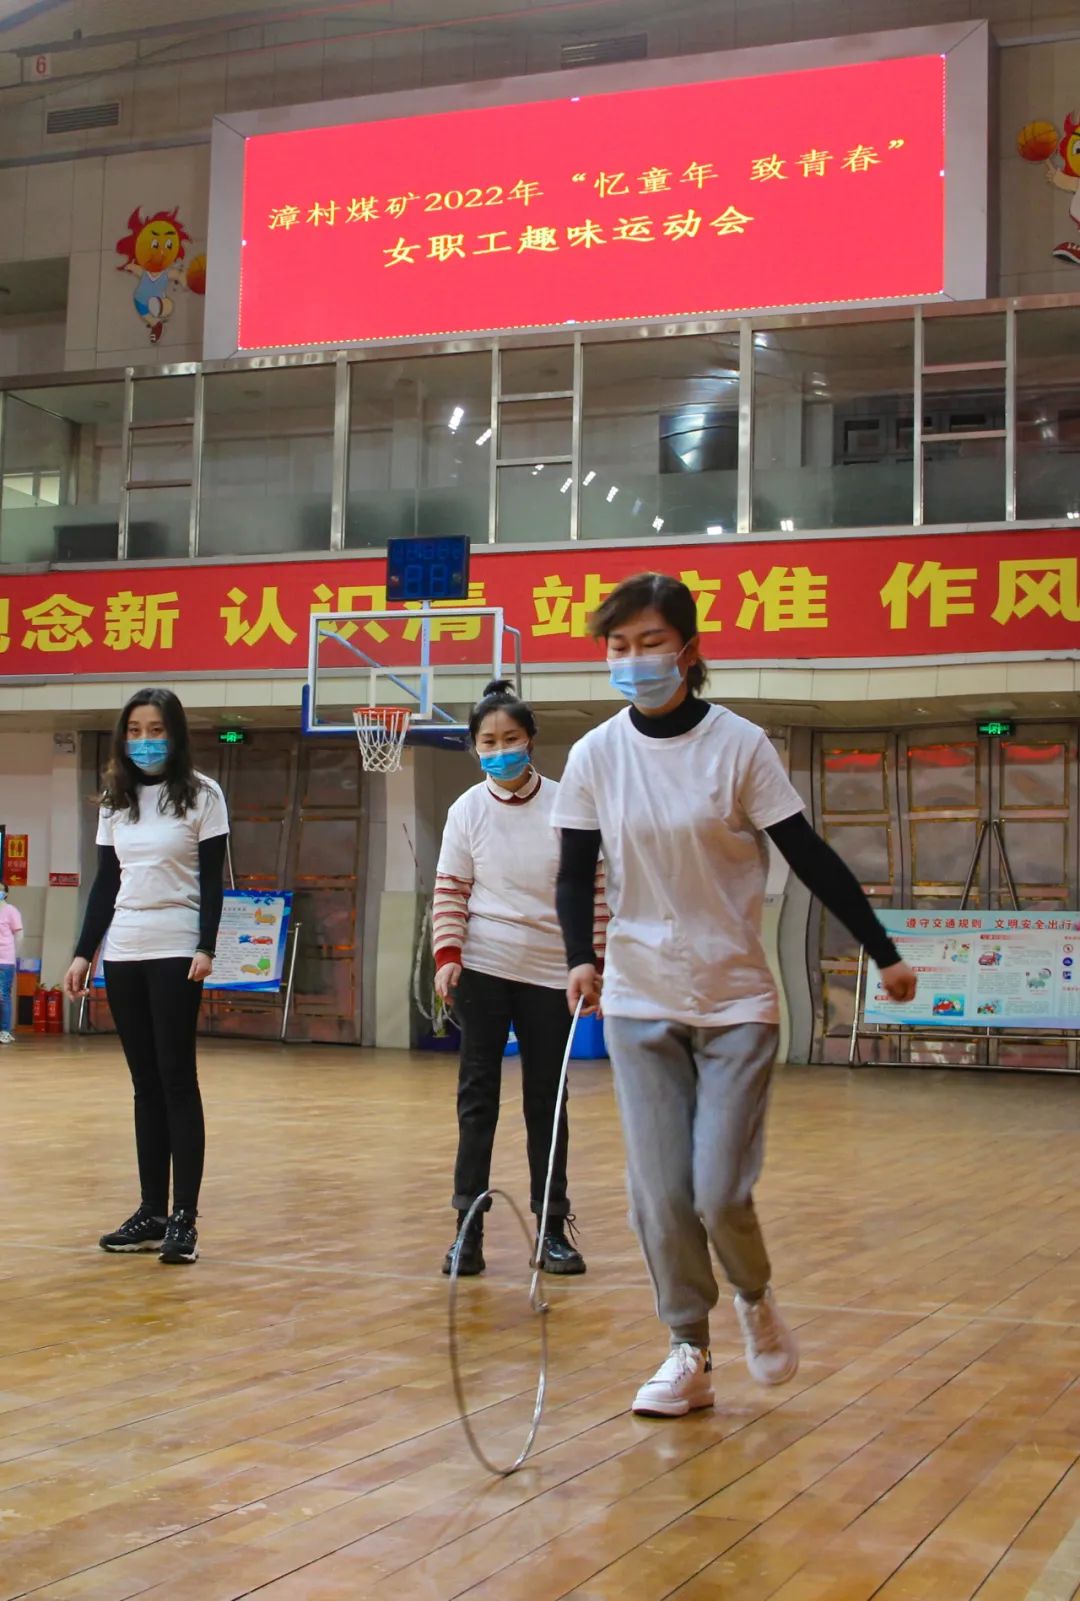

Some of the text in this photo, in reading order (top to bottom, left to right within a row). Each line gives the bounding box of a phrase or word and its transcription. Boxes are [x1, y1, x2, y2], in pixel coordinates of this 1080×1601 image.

[36, 56, 47, 74] 6
[268, 179, 544, 231] 漳村煤矿2022年
[382, 205, 755, 268] 女职工趣味运动会
[0, 591, 180, 653] 念新
[879, 556, 1080, 630] 作风
[906, 917, 1073, 930] 遵守交通规则 文明安全出行
